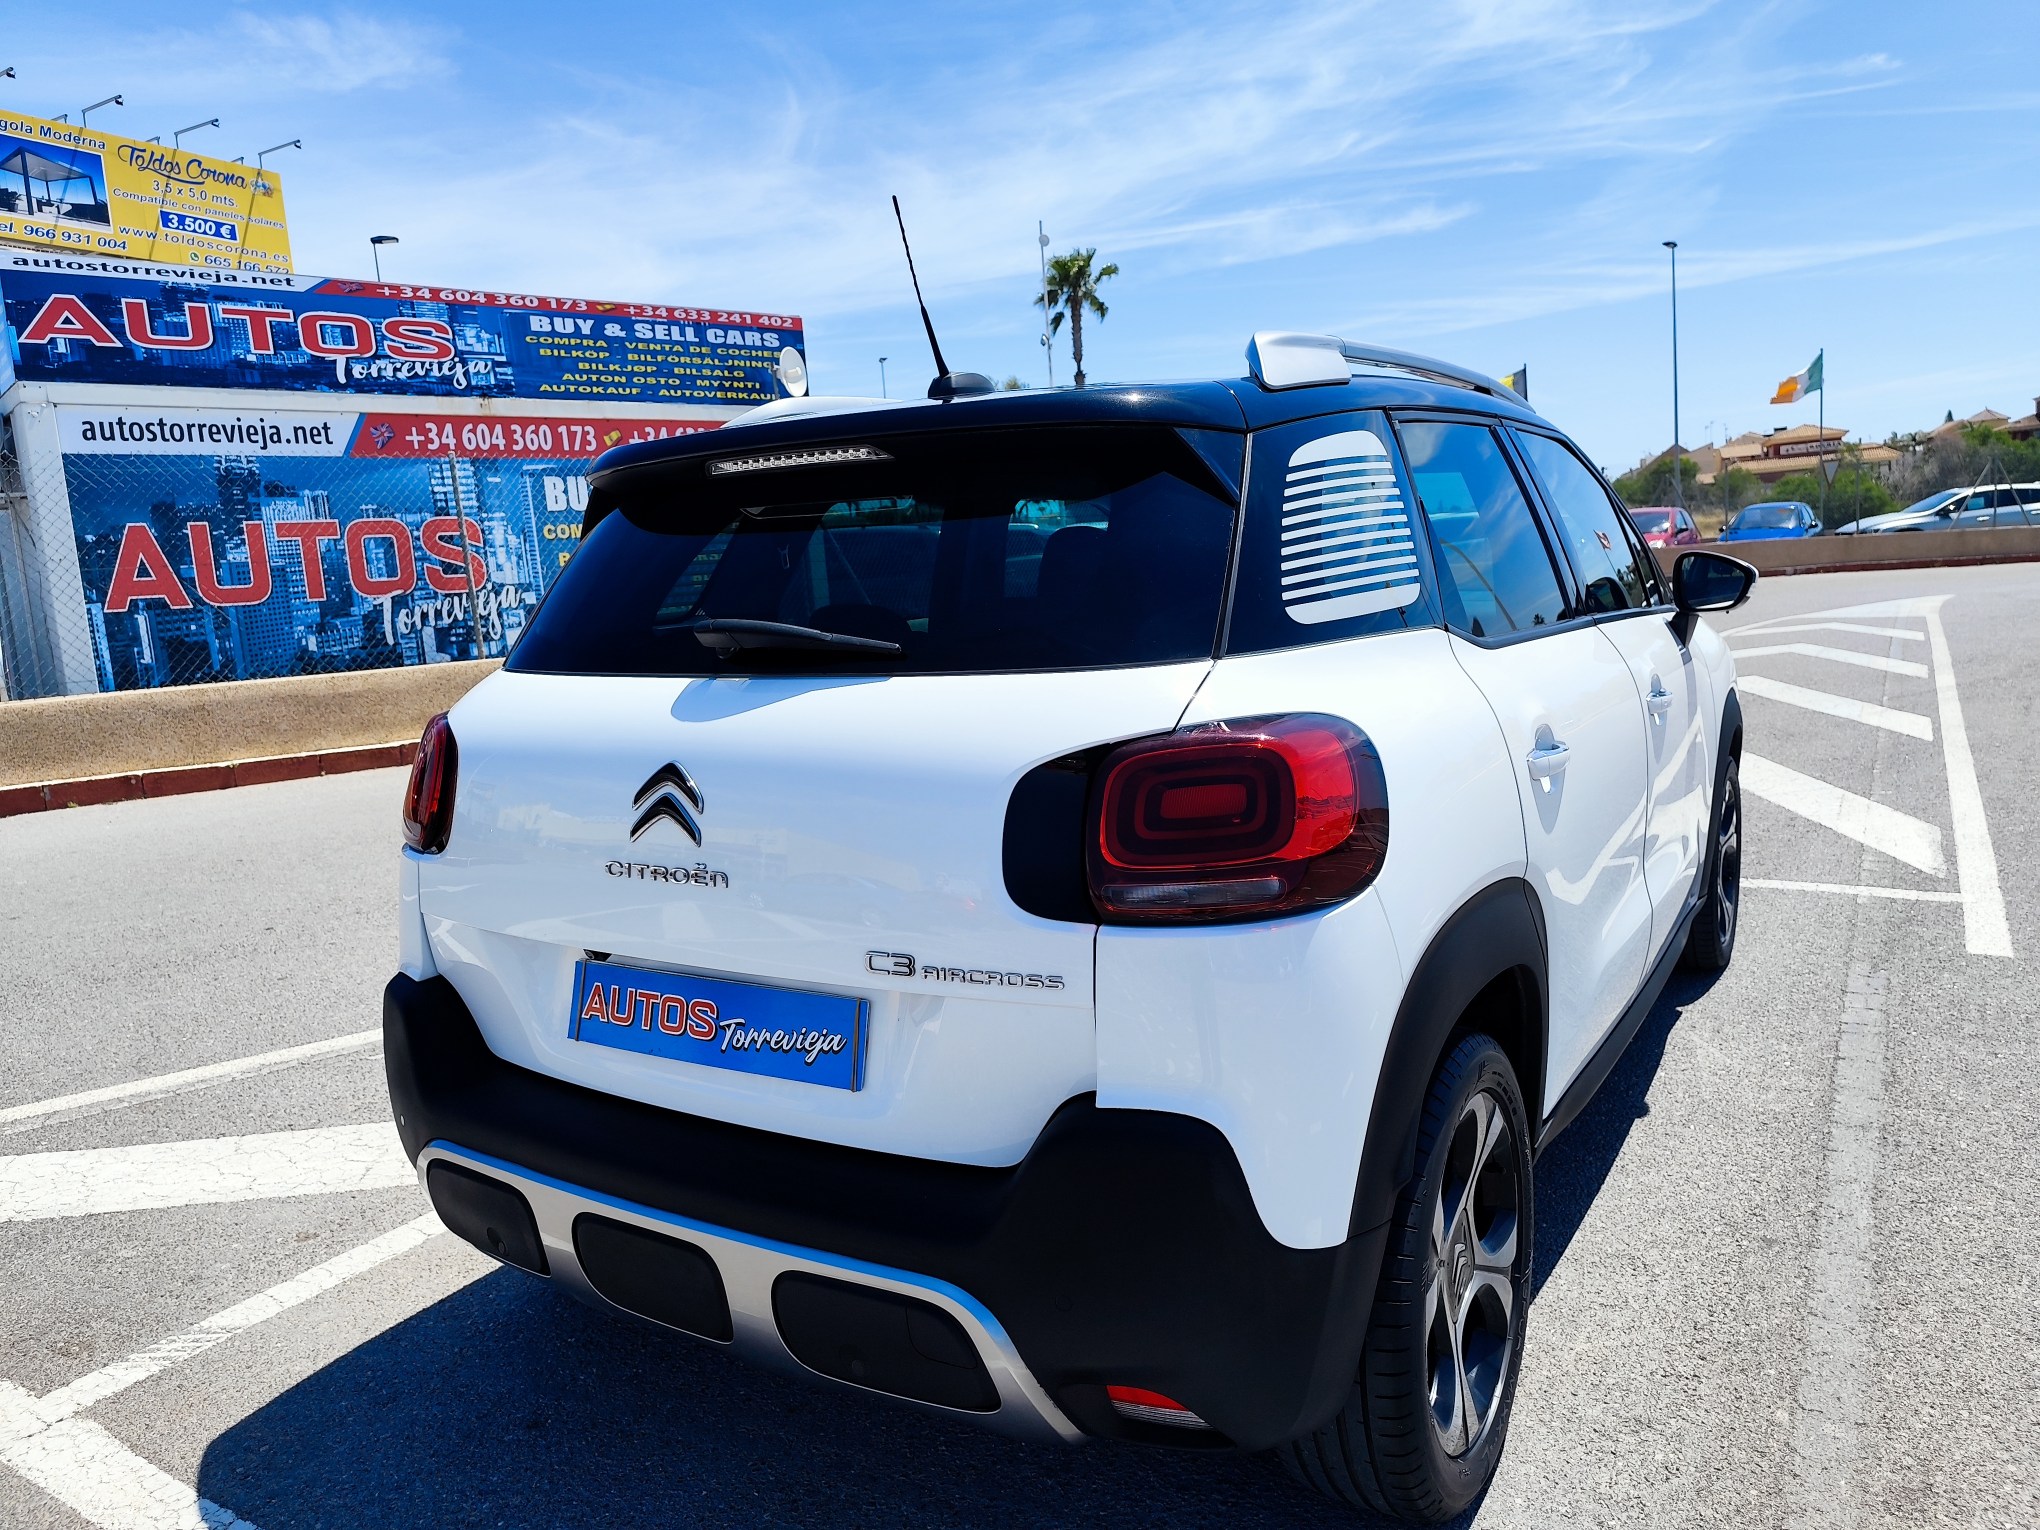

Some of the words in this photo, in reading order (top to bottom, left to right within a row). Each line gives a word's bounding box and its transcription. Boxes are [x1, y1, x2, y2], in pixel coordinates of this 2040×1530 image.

[40, 125, 105, 149] Moderna
[118, 145, 190, 181] Toldos
[186, 159, 247, 189] Corona
[153, 180, 172, 195] 3,5
[177, 187, 183, 195] x
[188, 188, 208, 201] 5,0
[211, 194, 238, 208] mts.
[113, 188, 178, 208] Compatible
[181, 203, 201, 212] con
[205, 207, 245, 221] paneles
[248, 216, 284, 229] solares
[24, 225, 56, 239] 966
[62, 231, 91, 245] 931
[97, 237, 127, 250] 004
[168, 214, 216, 235] 3.500
[220, 225, 232, 239] €
[119, 226, 289, 263] www.toldoscorona.es
[12, 255, 296, 288] autostorrevieja.net
[205, 255, 231, 267] 665
[236, 260, 260, 271] 166
[376, 286, 432, 299] +34
[439, 290, 487, 304] 604
[494, 294, 539, 307] 360
[546, 298, 587, 311] 173
[18, 294, 455, 361] AUTOS
[624, 306, 668, 317] +34
[674, 309, 710, 321] 633
[718, 313, 751, 324] 241
[758, 316, 793, 327] 402
[529, 315, 594, 335] BUY
[604, 322, 626, 338] &
[634, 324, 699, 342] SELL
[706, 328, 780, 347] CARS
[525, 335, 608, 348] COMPRA
[625, 341, 684, 353] VENTA
[690, 345, 711, 355] DE
[716, 347, 781, 359] COCHES
[539, 348, 610, 359] BILKÖP
[331, 354, 490, 390] Torrevieja
[562, 373, 627, 383] AUTON
[632, 376, 681, 386] OSTO
[696, 379, 761, 389] MYYNTI
[578, 362, 657, 374] BILKJØP
[673, 366, 745, 378] BILSALG
[539, 383, 641, 395] AUTOKAUF
[81, 416, 334, 450] autostorrevieja.net
[405, 422, 457, 451] +34
[462, 423, 505, 451] 604
[510, 424, 553, 451] 360
[557, 425, 597, 451] 173
[104, 517, 487, 613] AUTOS
[373, 582, 521, 646] Torreveja
[604, 862, 729, 889] CITROËN
[864, 951, 916, 977] C3
[920, 966, 1066, 990] AIRCROSS
[582, 982, 718, 1041] AUTOS
[719, 1018, 847, 1064] Torrevieja
